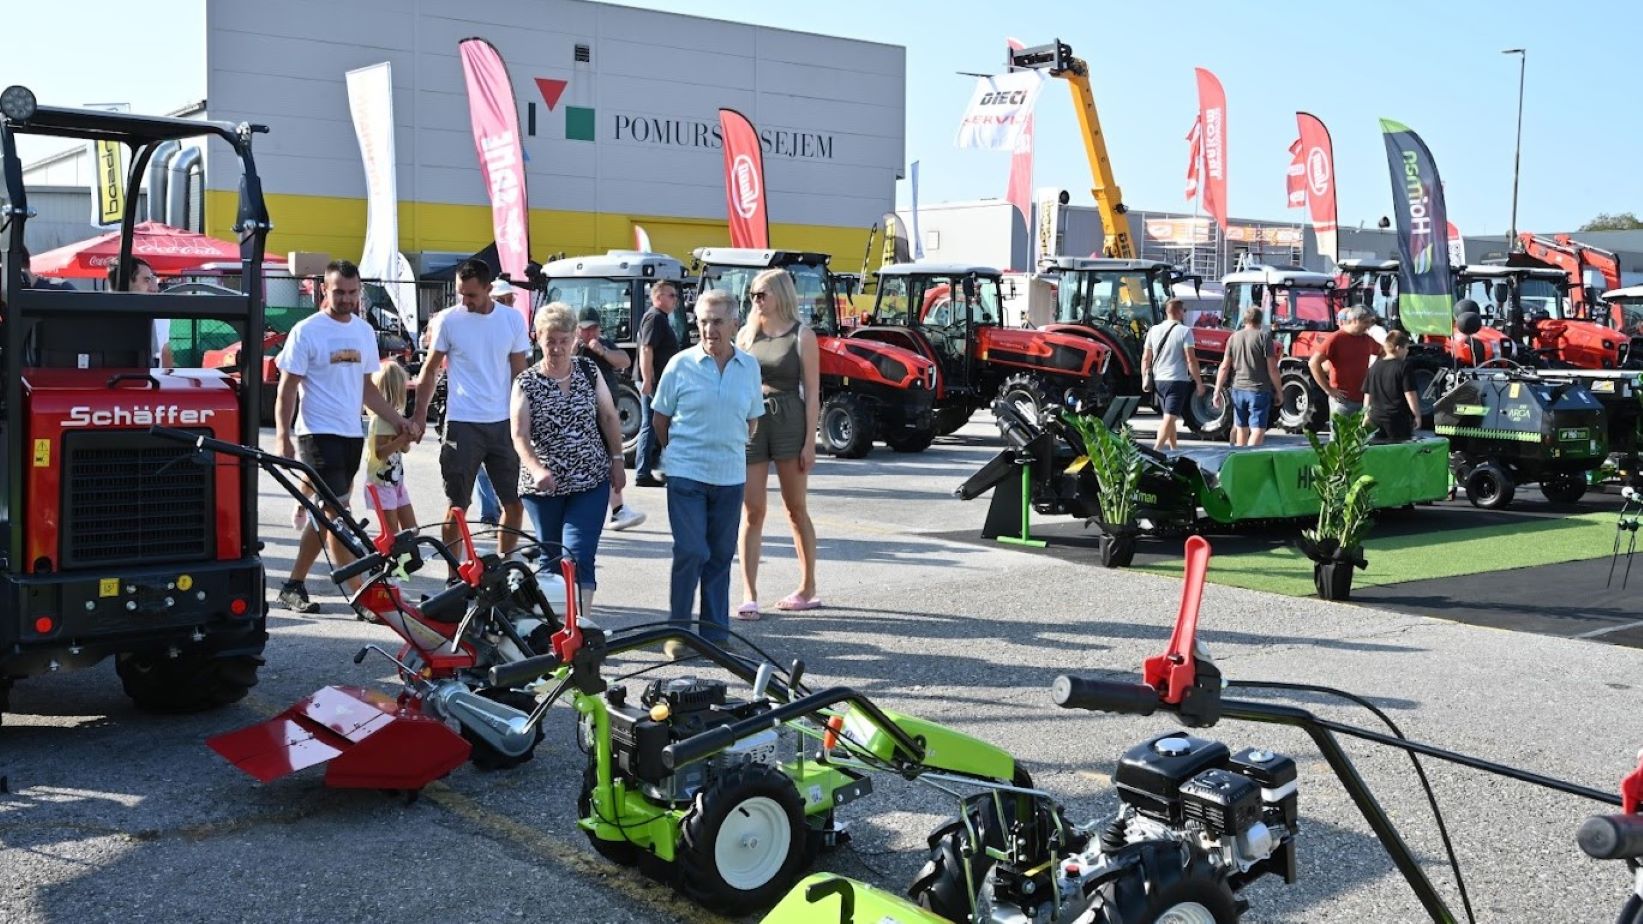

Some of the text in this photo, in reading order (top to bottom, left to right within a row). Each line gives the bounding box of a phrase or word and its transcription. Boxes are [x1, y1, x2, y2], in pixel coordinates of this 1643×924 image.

[980, 88, 1028, 106] DIECI
[614, 114, 834, 159] POMURS SEJEM
[60, 405, 215, 427] Schäffer
[1132, 489, 1158, 505] iman
